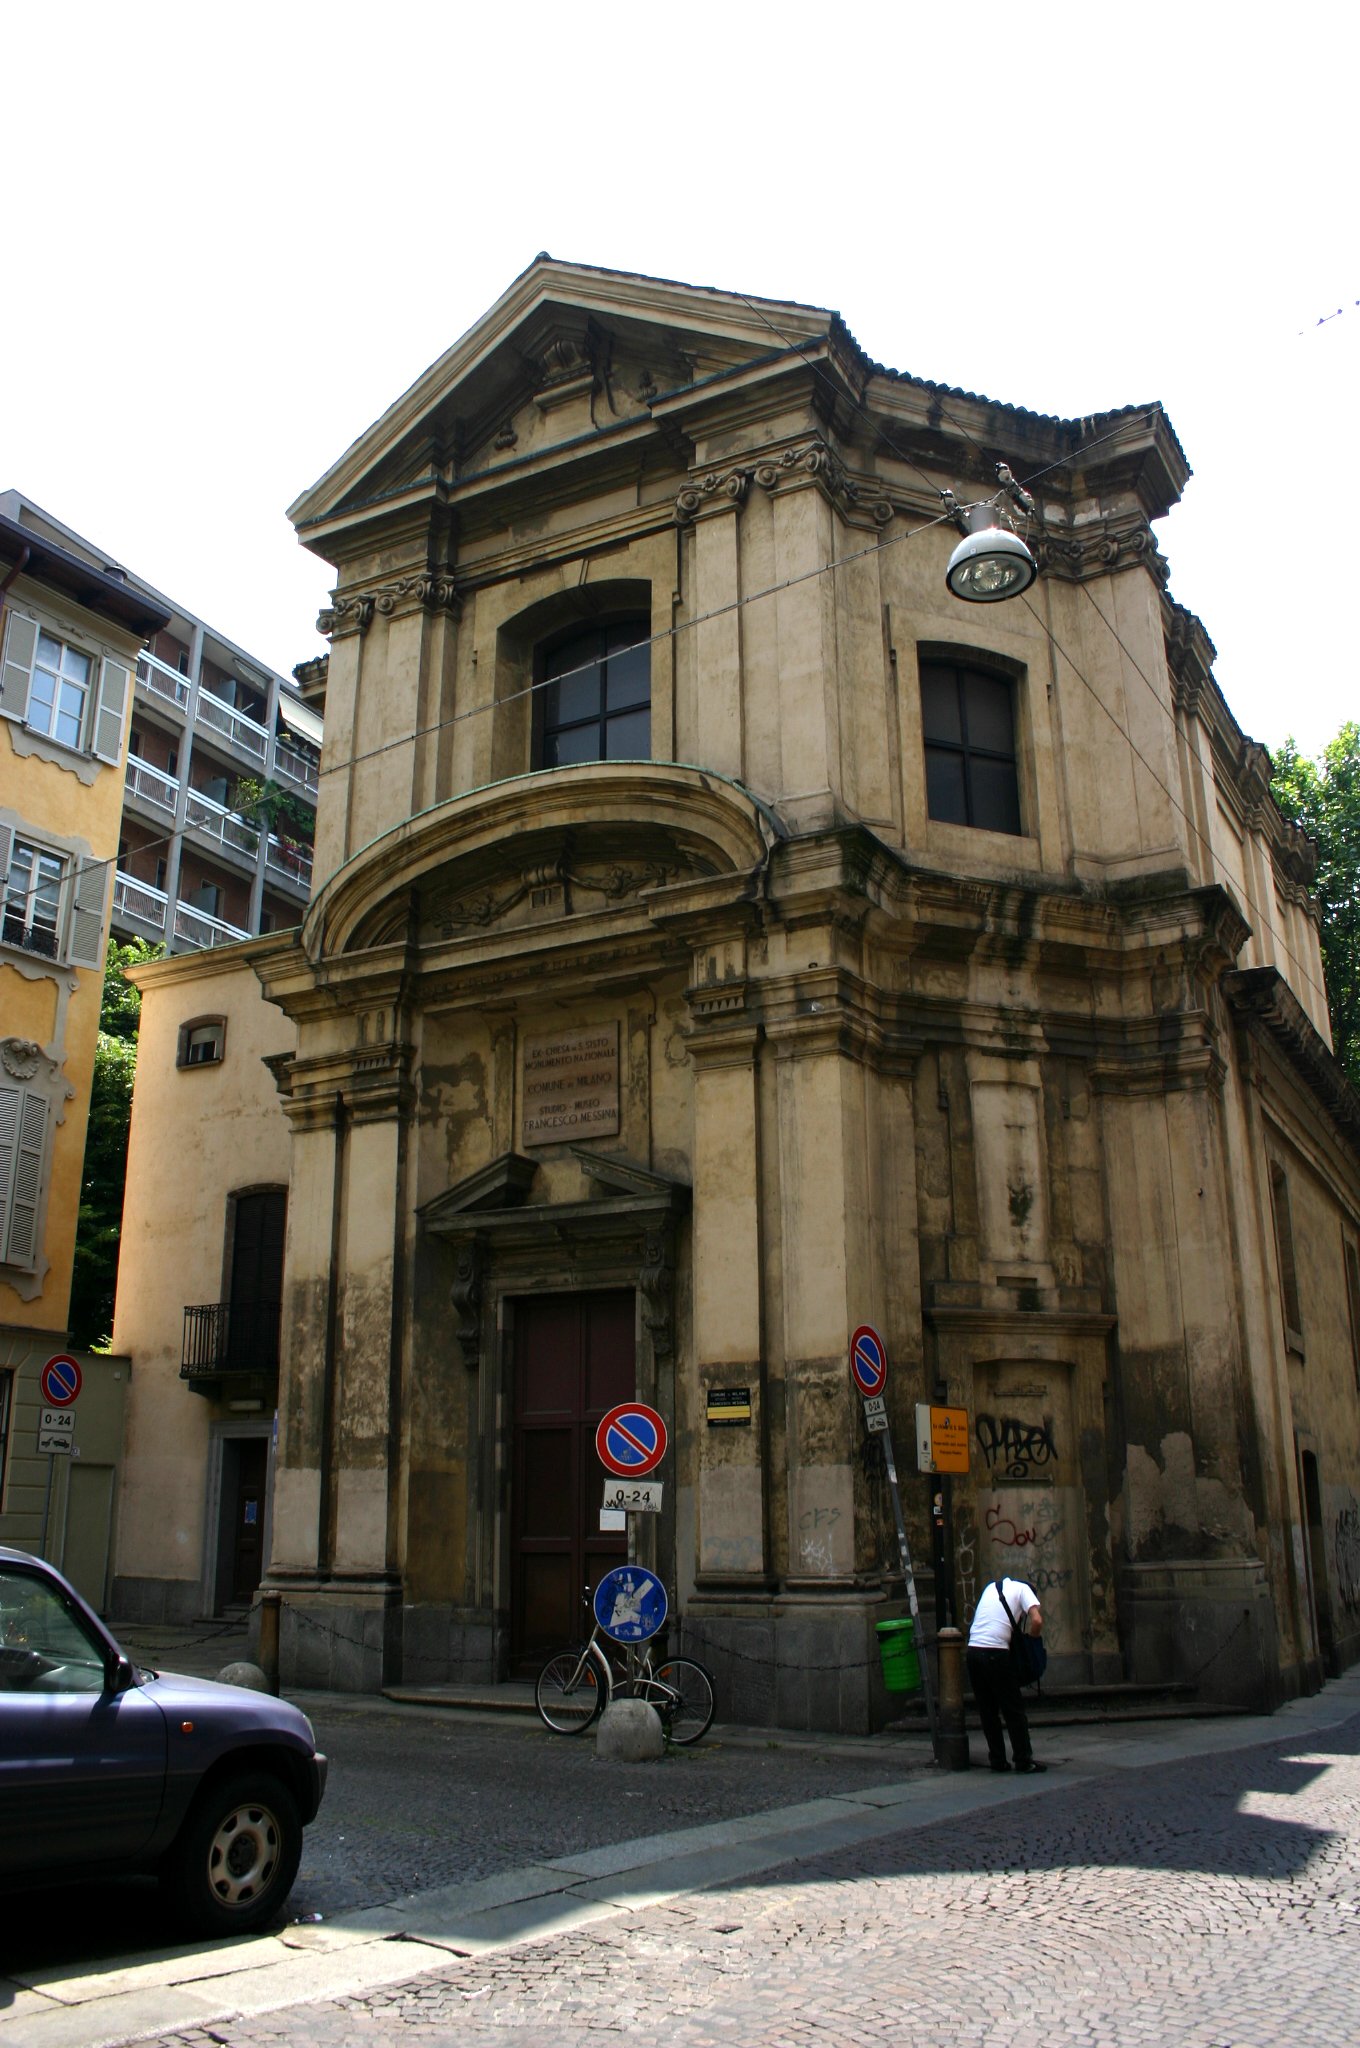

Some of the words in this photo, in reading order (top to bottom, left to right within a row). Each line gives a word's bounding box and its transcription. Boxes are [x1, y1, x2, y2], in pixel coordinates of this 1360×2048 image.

[525, 1056, 572, 1071] MONUMENTO
[574, 1048, 616, 1062] NAZIONALE
[528, 1080, 564, 1093] COMUNE
[577, 1072, 611, 1086] MILANO
[539, 1103, 567, 1115] STUDIO
[575, 1098, 600, 1110] MUSEO
[524, 1114, 577, 1131] FRANCESCO
[581, 1110, 616, 1123] MESSINA
[616, 1489, 650, 1503] 0-24
